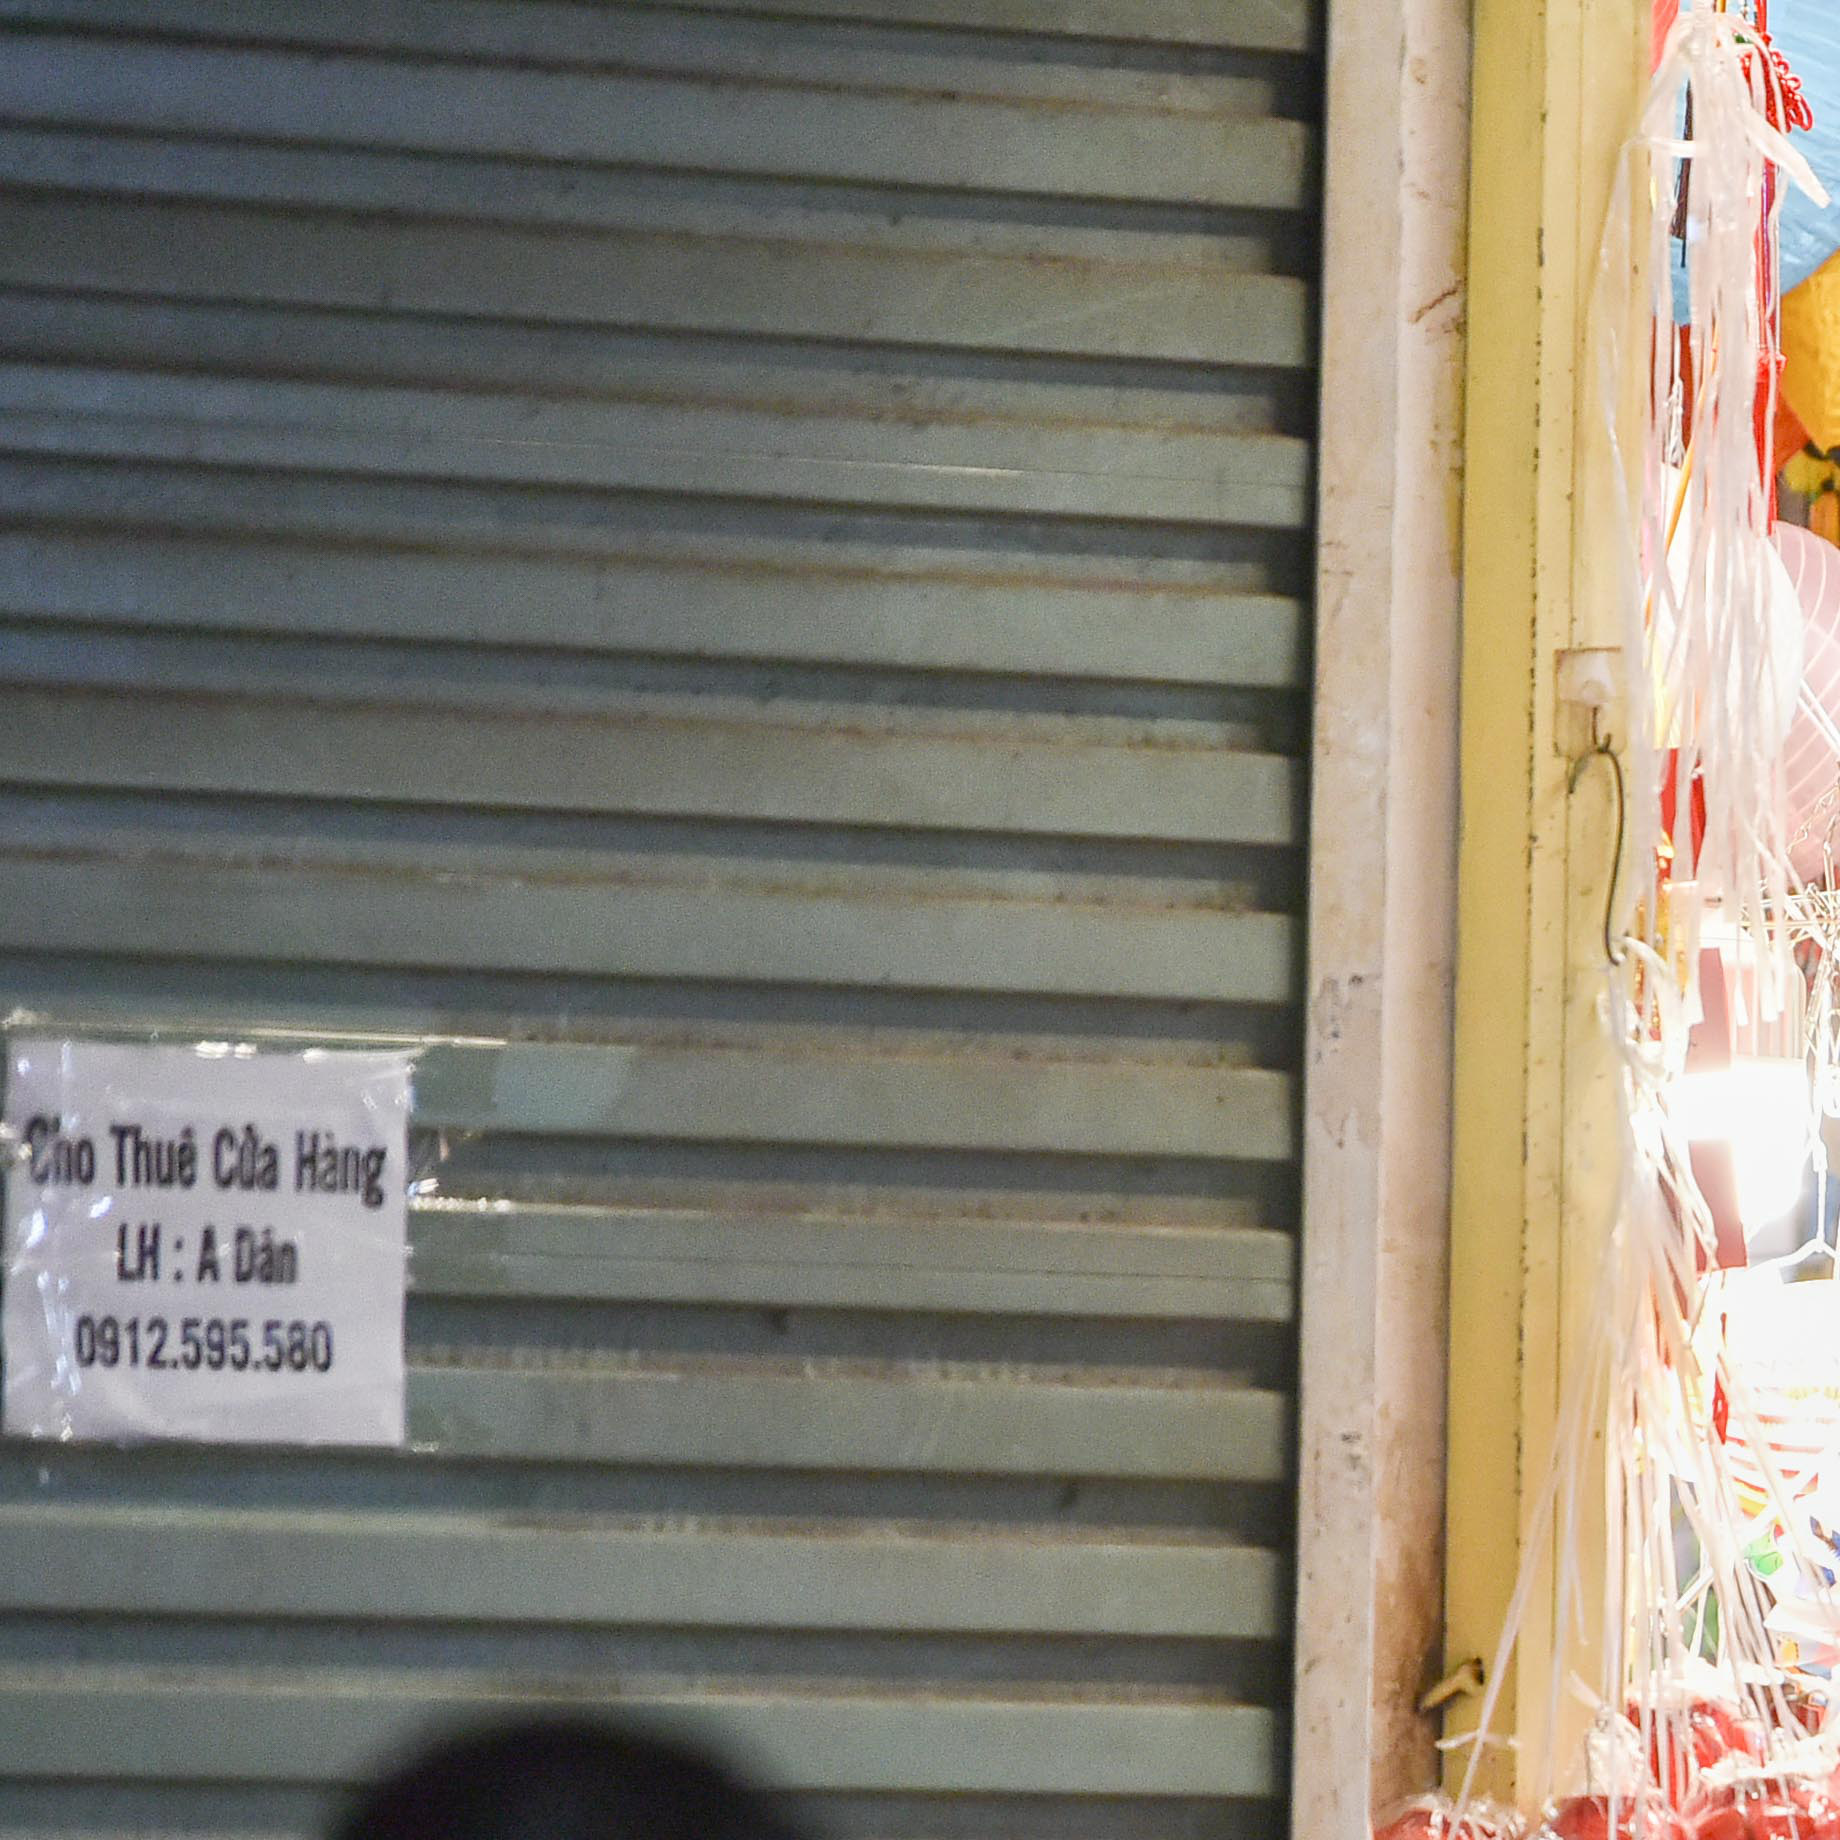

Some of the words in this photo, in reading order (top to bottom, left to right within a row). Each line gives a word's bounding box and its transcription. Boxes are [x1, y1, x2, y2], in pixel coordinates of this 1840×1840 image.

[108, 1122, 197, 1190] Thuê
[210, 1123, 281, 1192] Cửa
[293, 1129, 388, 1209] Hàng
[115, 1222, 162, 1283] LH
[197, 1225, 219, 1284] A
[74, 1315, 334, 1373] 0912.595.580
